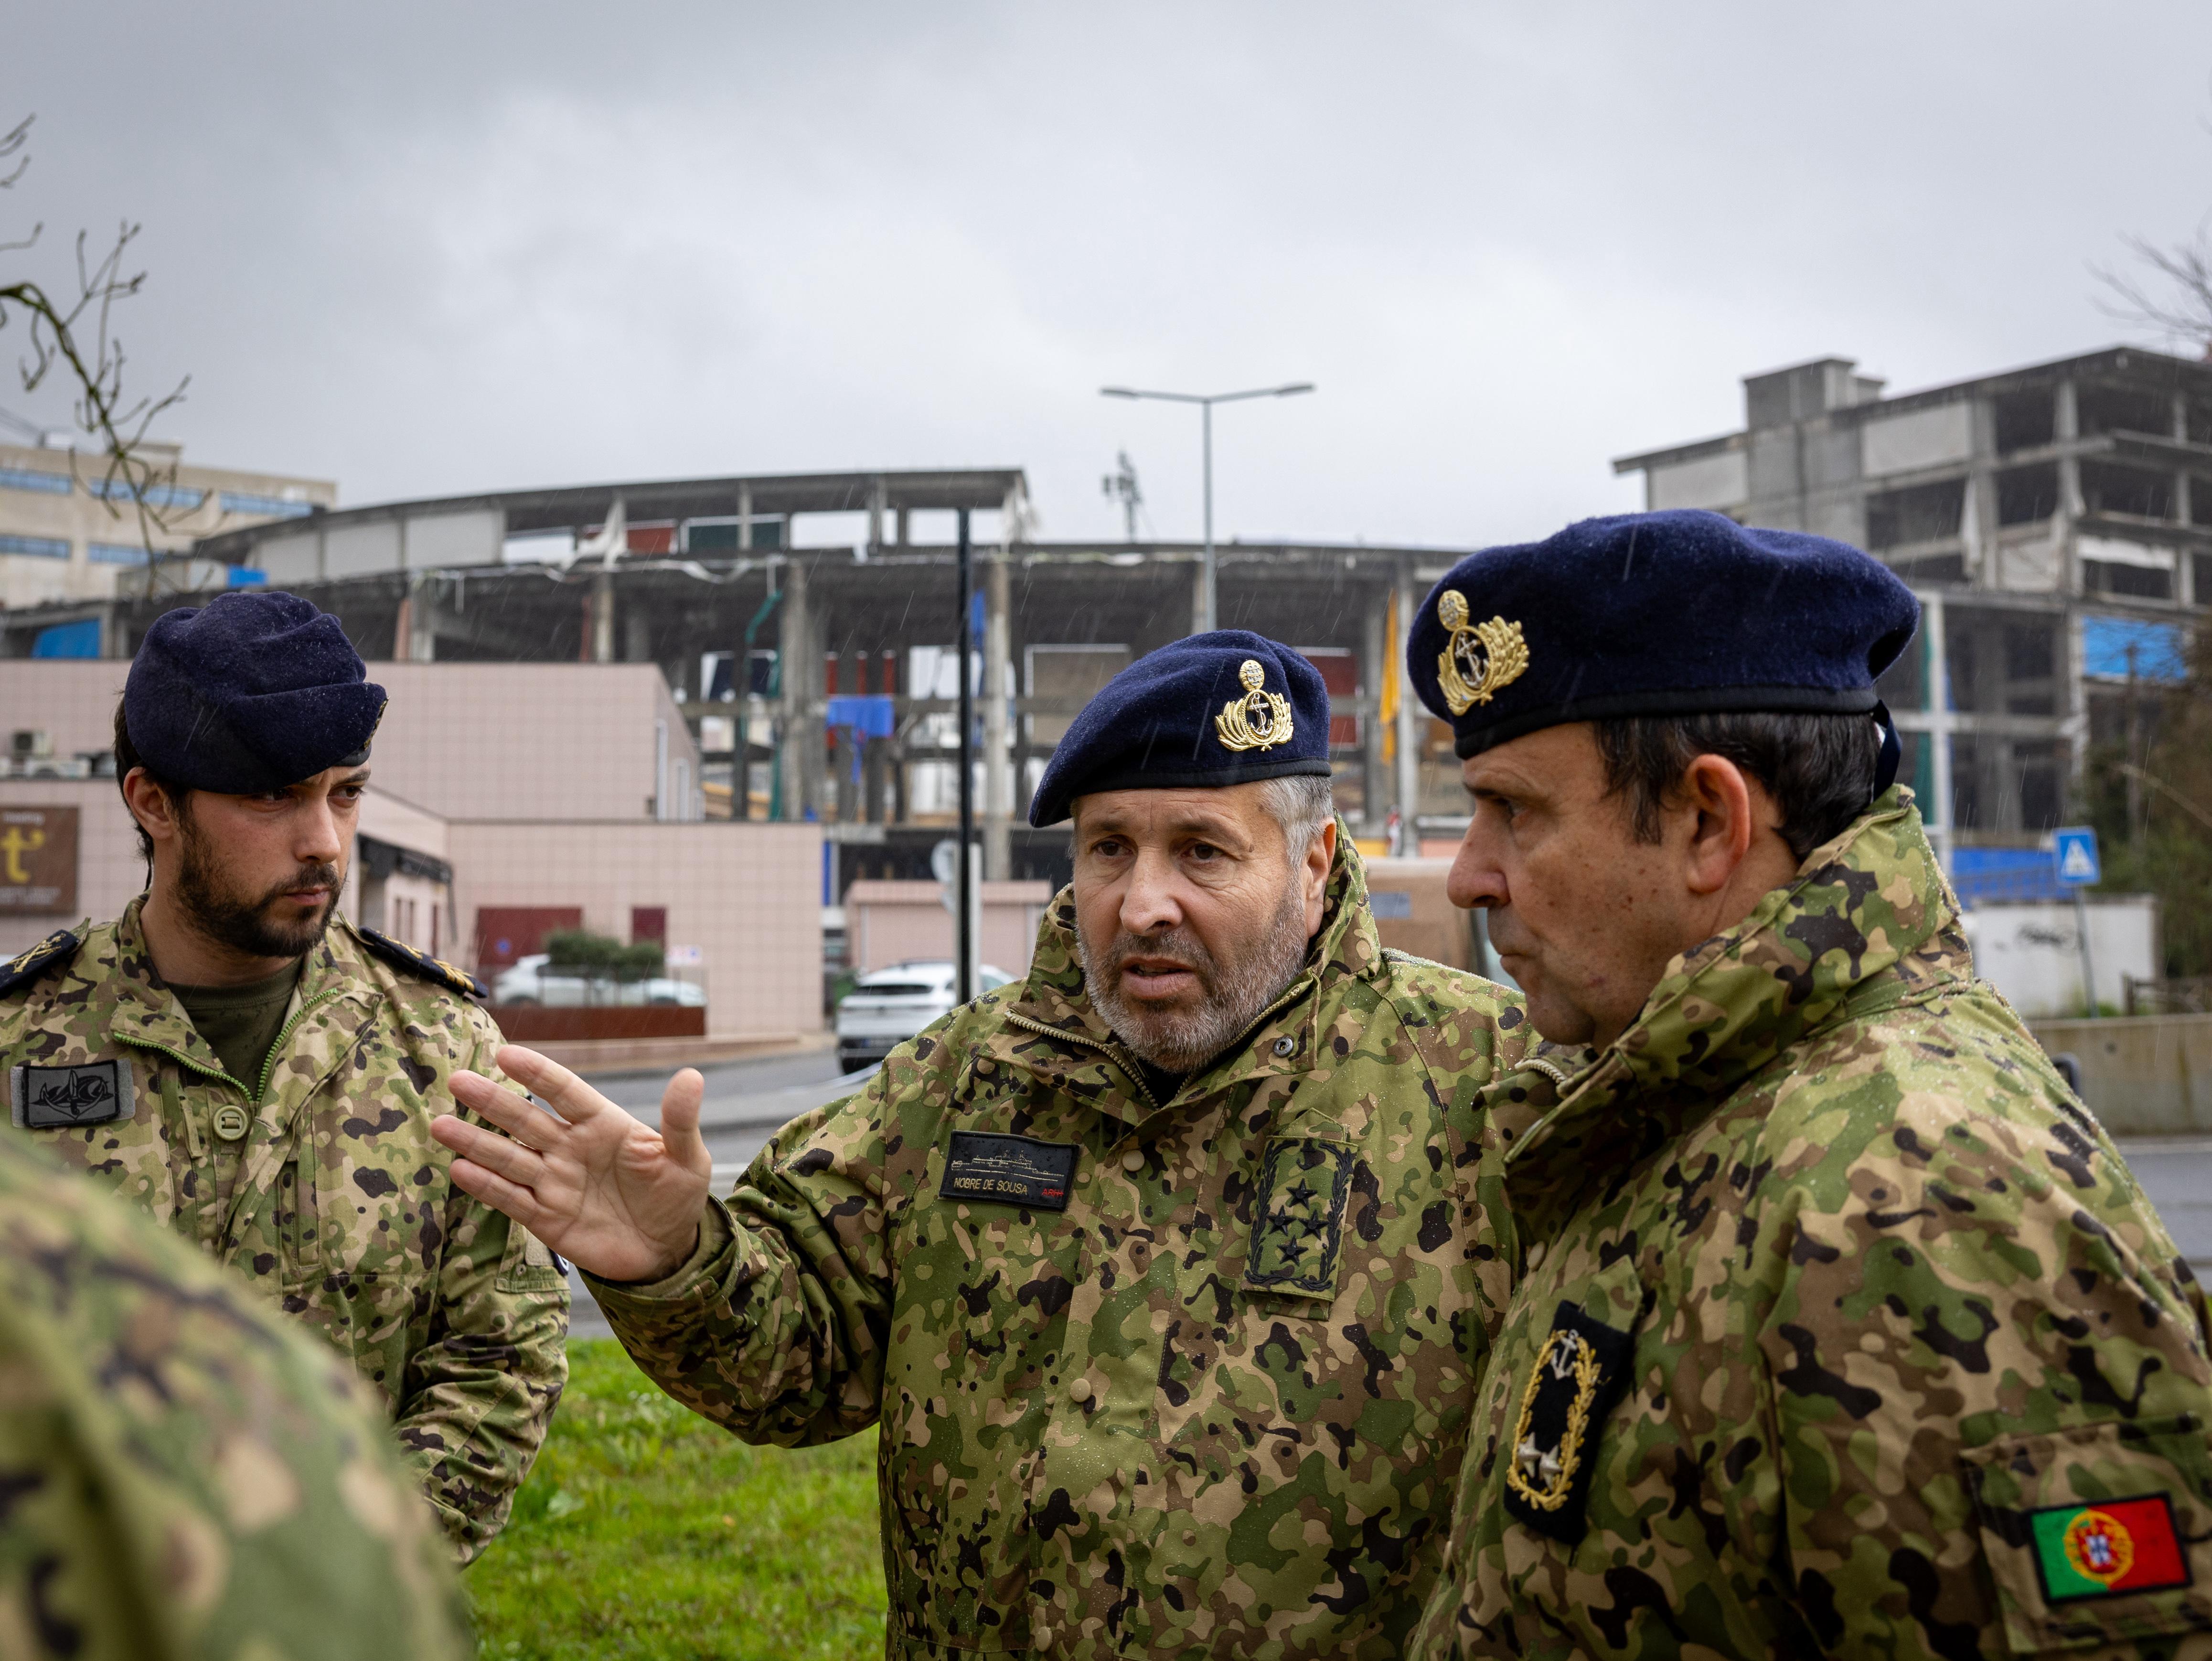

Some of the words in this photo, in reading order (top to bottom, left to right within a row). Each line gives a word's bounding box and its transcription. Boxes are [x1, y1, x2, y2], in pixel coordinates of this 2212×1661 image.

[954, 1178, 982, 1189] NOBRE
[983, 1179, 995, 1190] DE
[996, 1180, 1027, 1195] SOUSA
